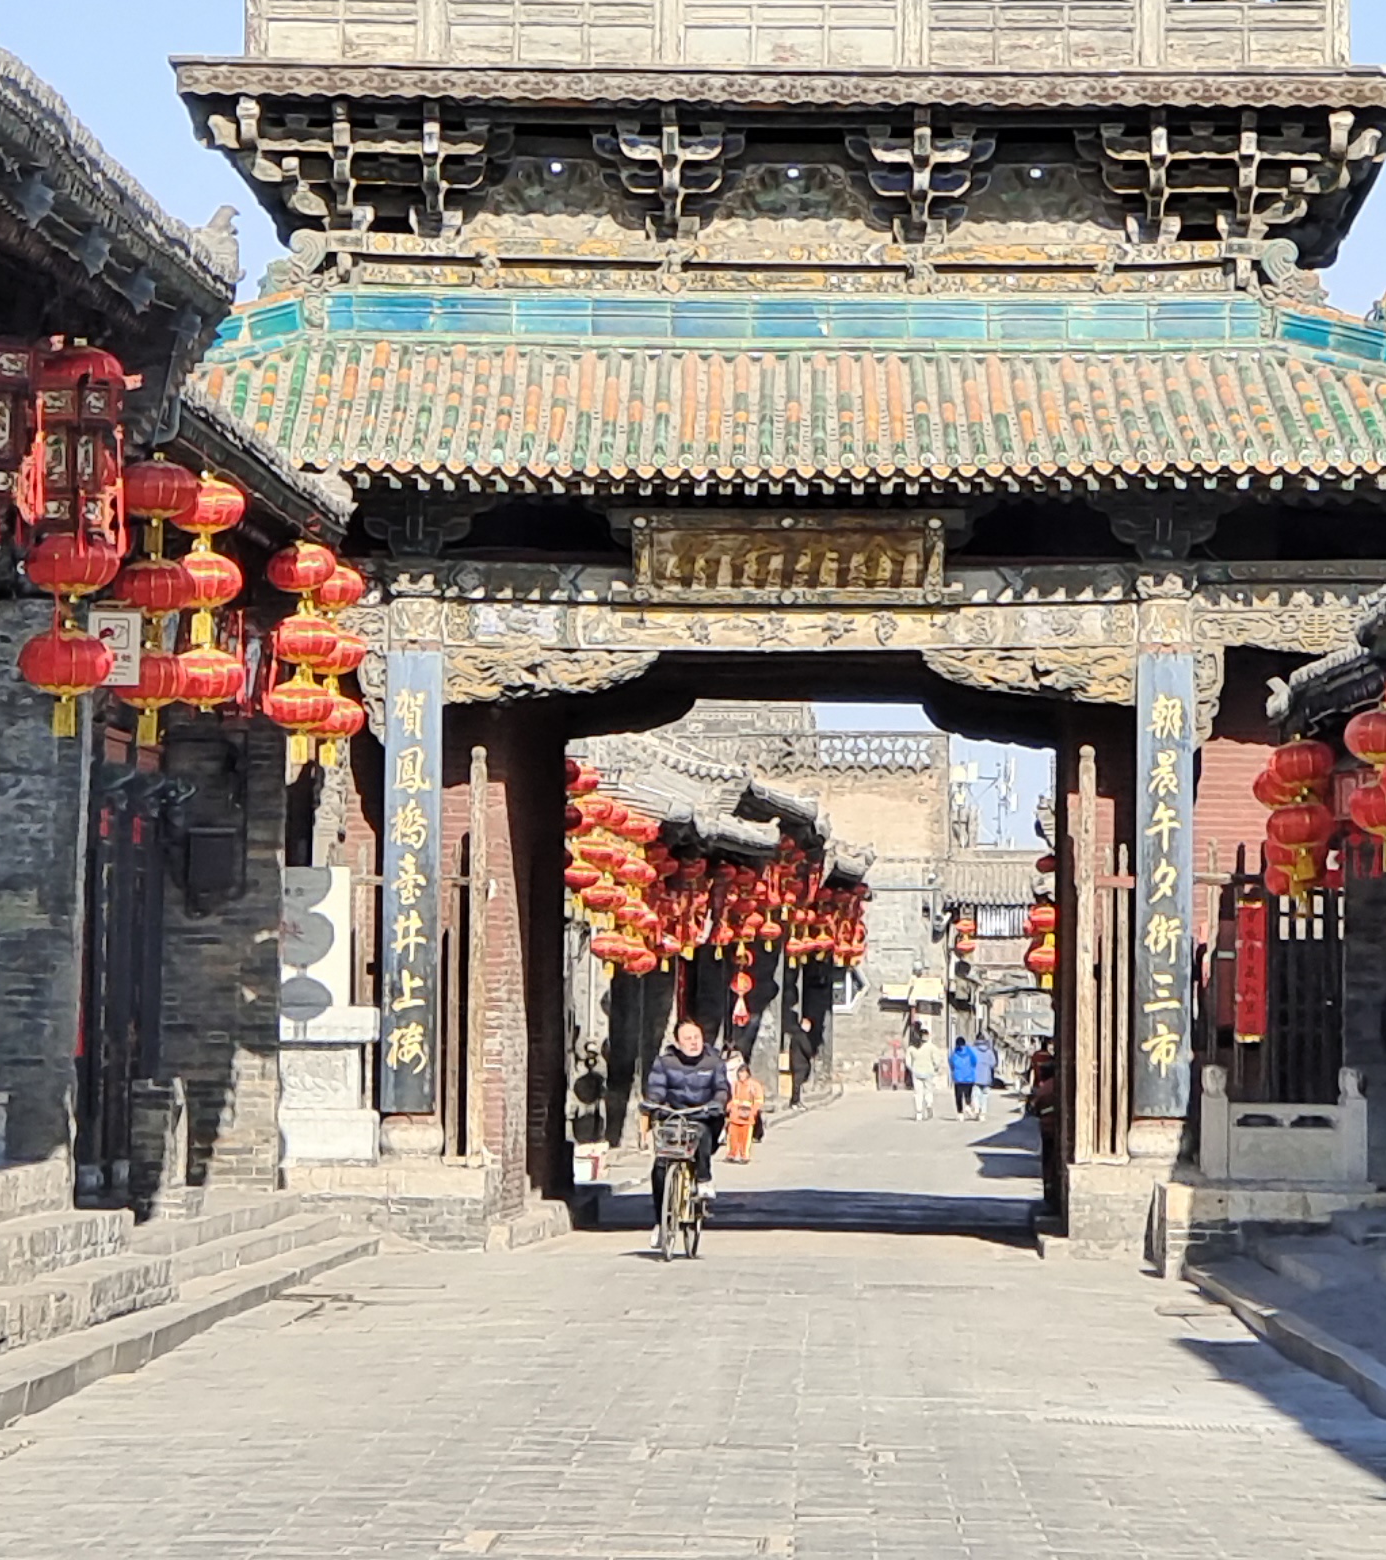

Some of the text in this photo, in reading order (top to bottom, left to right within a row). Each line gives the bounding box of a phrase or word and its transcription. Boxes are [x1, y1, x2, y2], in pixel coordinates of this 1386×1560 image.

[1140, 693, 1184, 1079] 朝晨午夕街三市
